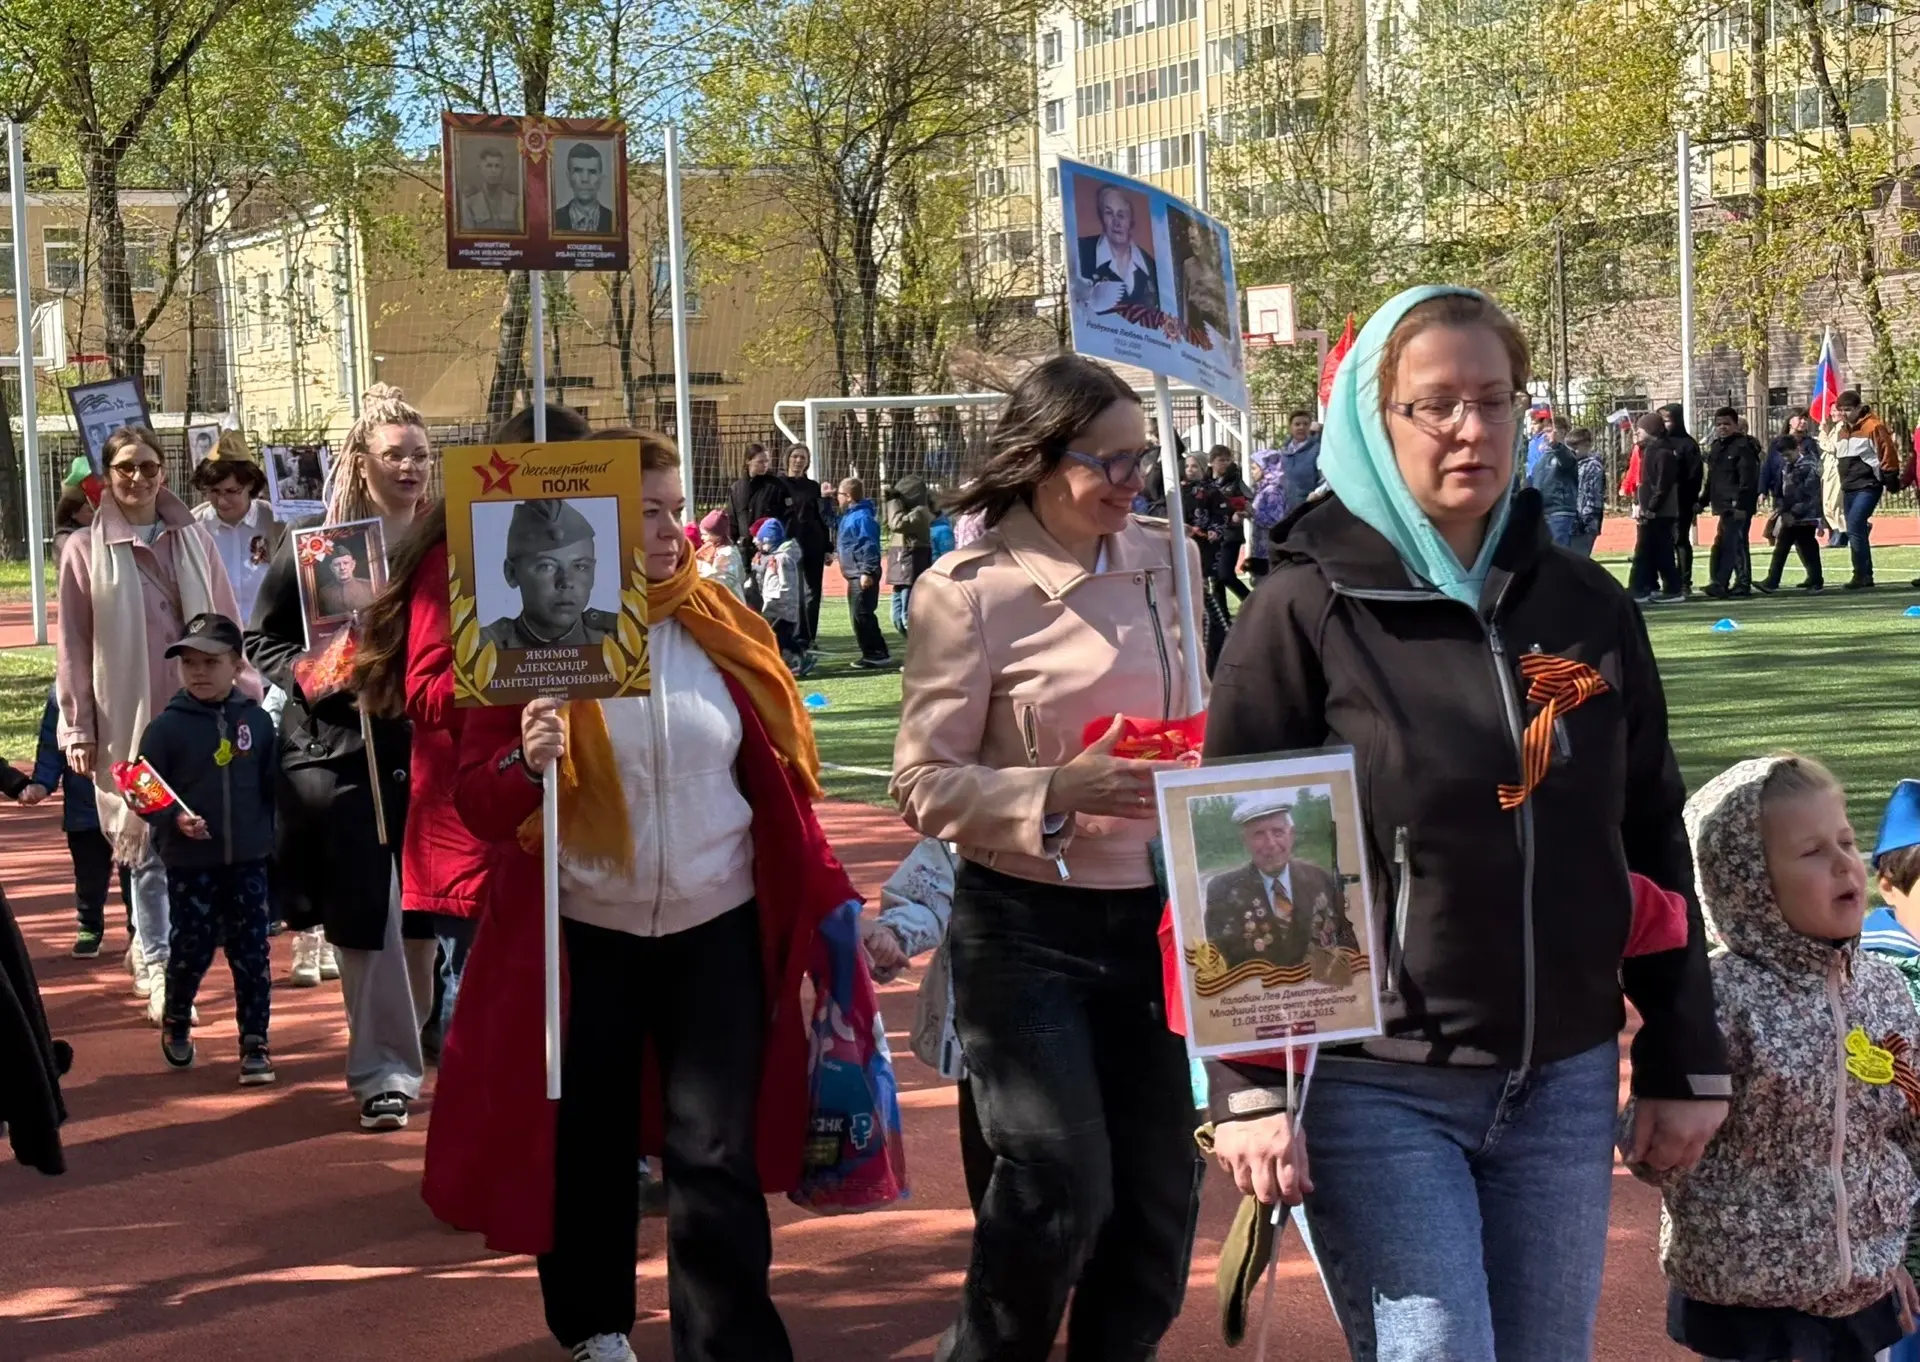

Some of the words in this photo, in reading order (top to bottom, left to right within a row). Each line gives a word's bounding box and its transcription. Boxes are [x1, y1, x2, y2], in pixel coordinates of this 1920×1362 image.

[542, 478, 591, 493] ПОЛК
[525, 648, 579, 660] ЯКИМОВ
[514, 660, 588, 674] АЛЕКСАНДР
[490, 673, 618, 689] ПАНТЕЛЕЙМОНОВИЧ
[1262, 991, 1281, 1001] Лев
[1281, 985, 1344, 1001] Дмитриевич
[1209, 1004, 1256, 1019] Младший
[1308, 995, 1357, 1009] ефрейтор
